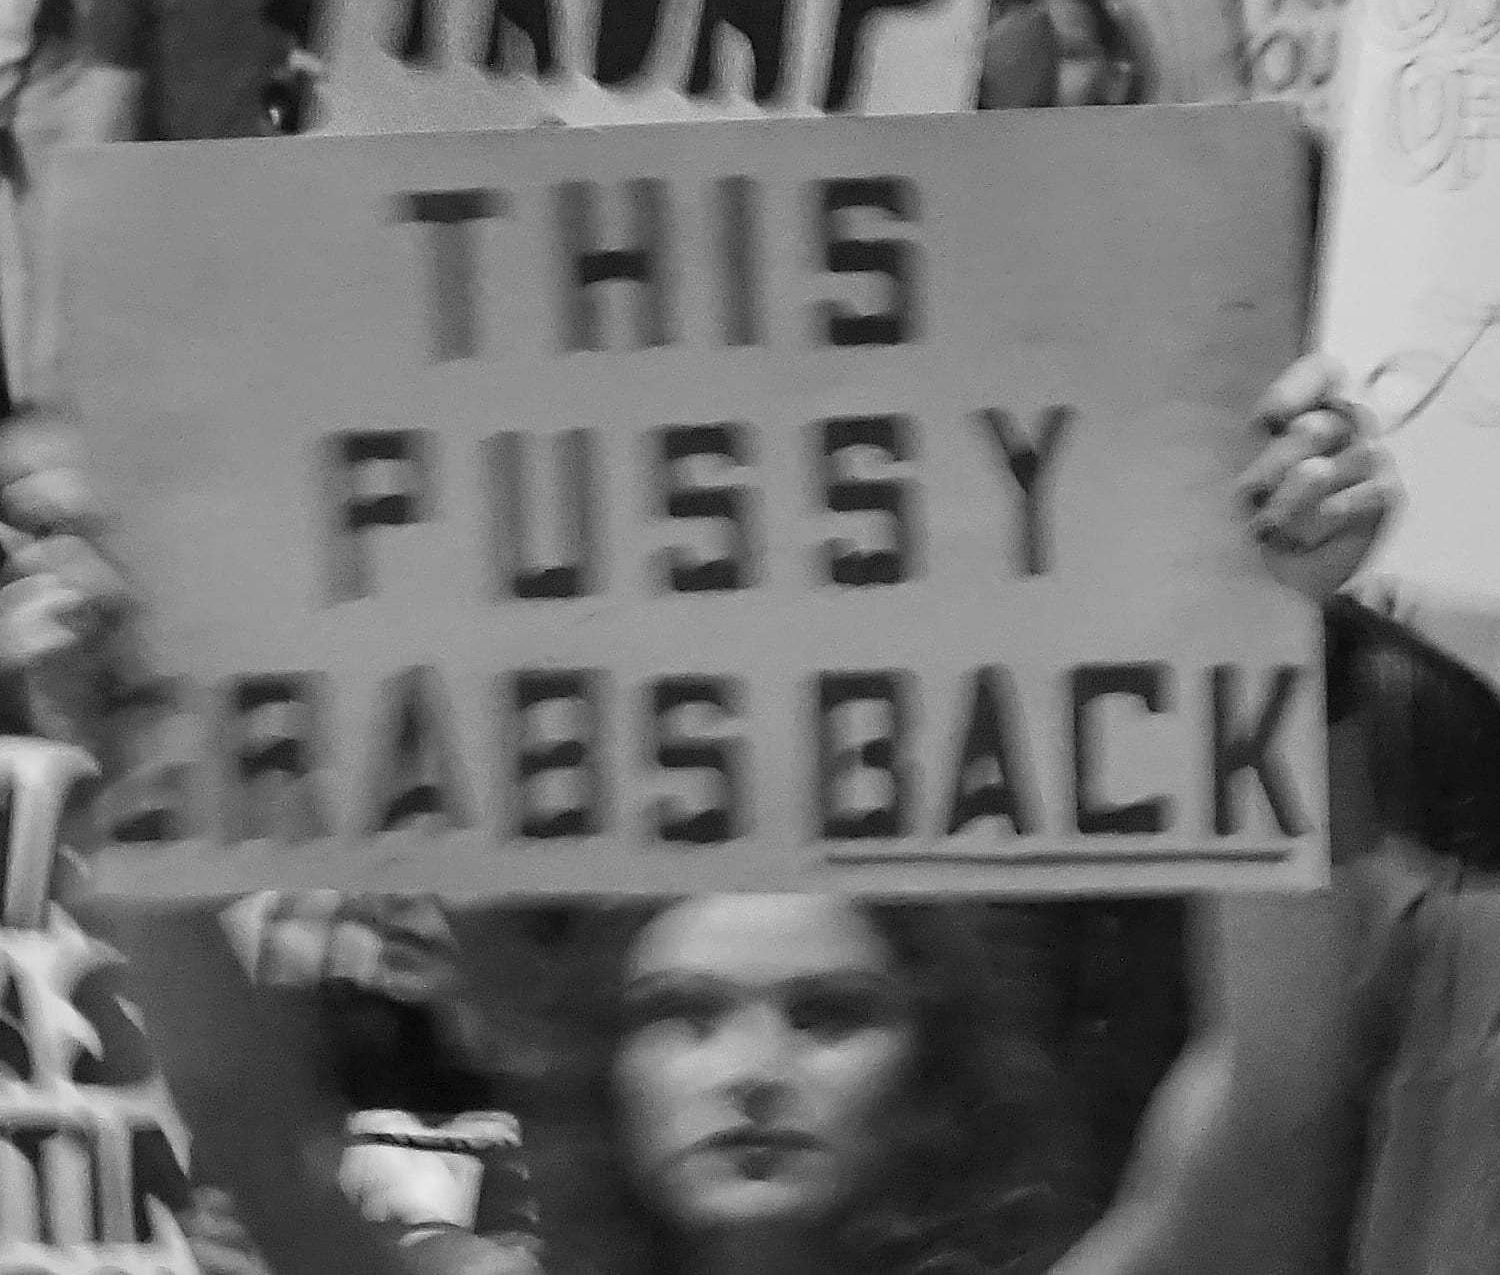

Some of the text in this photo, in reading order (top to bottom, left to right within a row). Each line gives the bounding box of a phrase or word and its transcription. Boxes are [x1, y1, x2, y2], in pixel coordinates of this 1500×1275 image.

[383, 174, 930, 363] THIS
[312, 404, 1090, 612] PUSSY
[807, 663, 1318, 841] BACK
